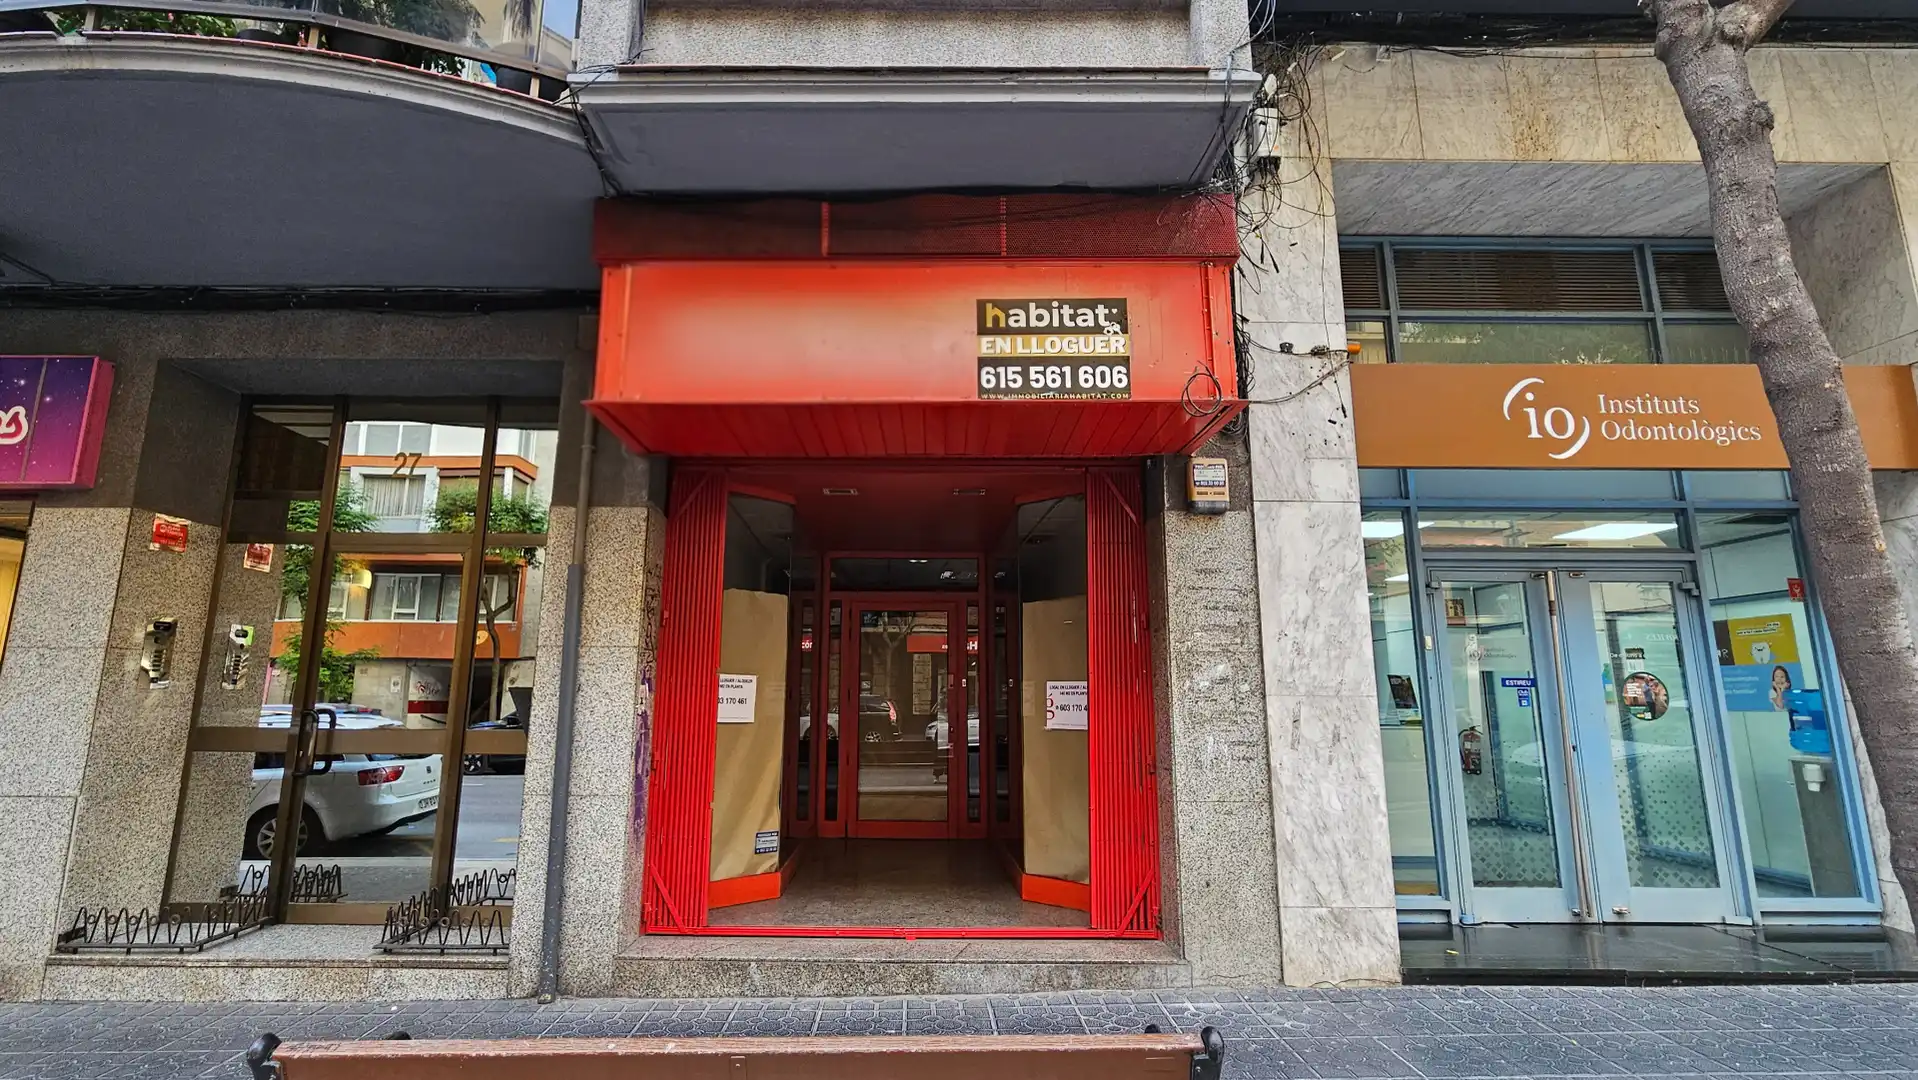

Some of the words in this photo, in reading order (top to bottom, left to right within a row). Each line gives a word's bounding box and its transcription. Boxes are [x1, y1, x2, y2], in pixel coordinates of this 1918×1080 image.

[985, 301, 1110, 328] habitat
[981, 337, 1012, 355] EN
[1016, 336, 1127, 355] LLOGUER
[980, 365, 1023, 389] 615
[1030, 365, 1072, 389] 561
[1078, 365, 1128, 389] 606
[1598, 393, 1700, 415] Instituts
[1601, 420, 1762, 447] Odontològics
[391, 451, 422, 479] 27
